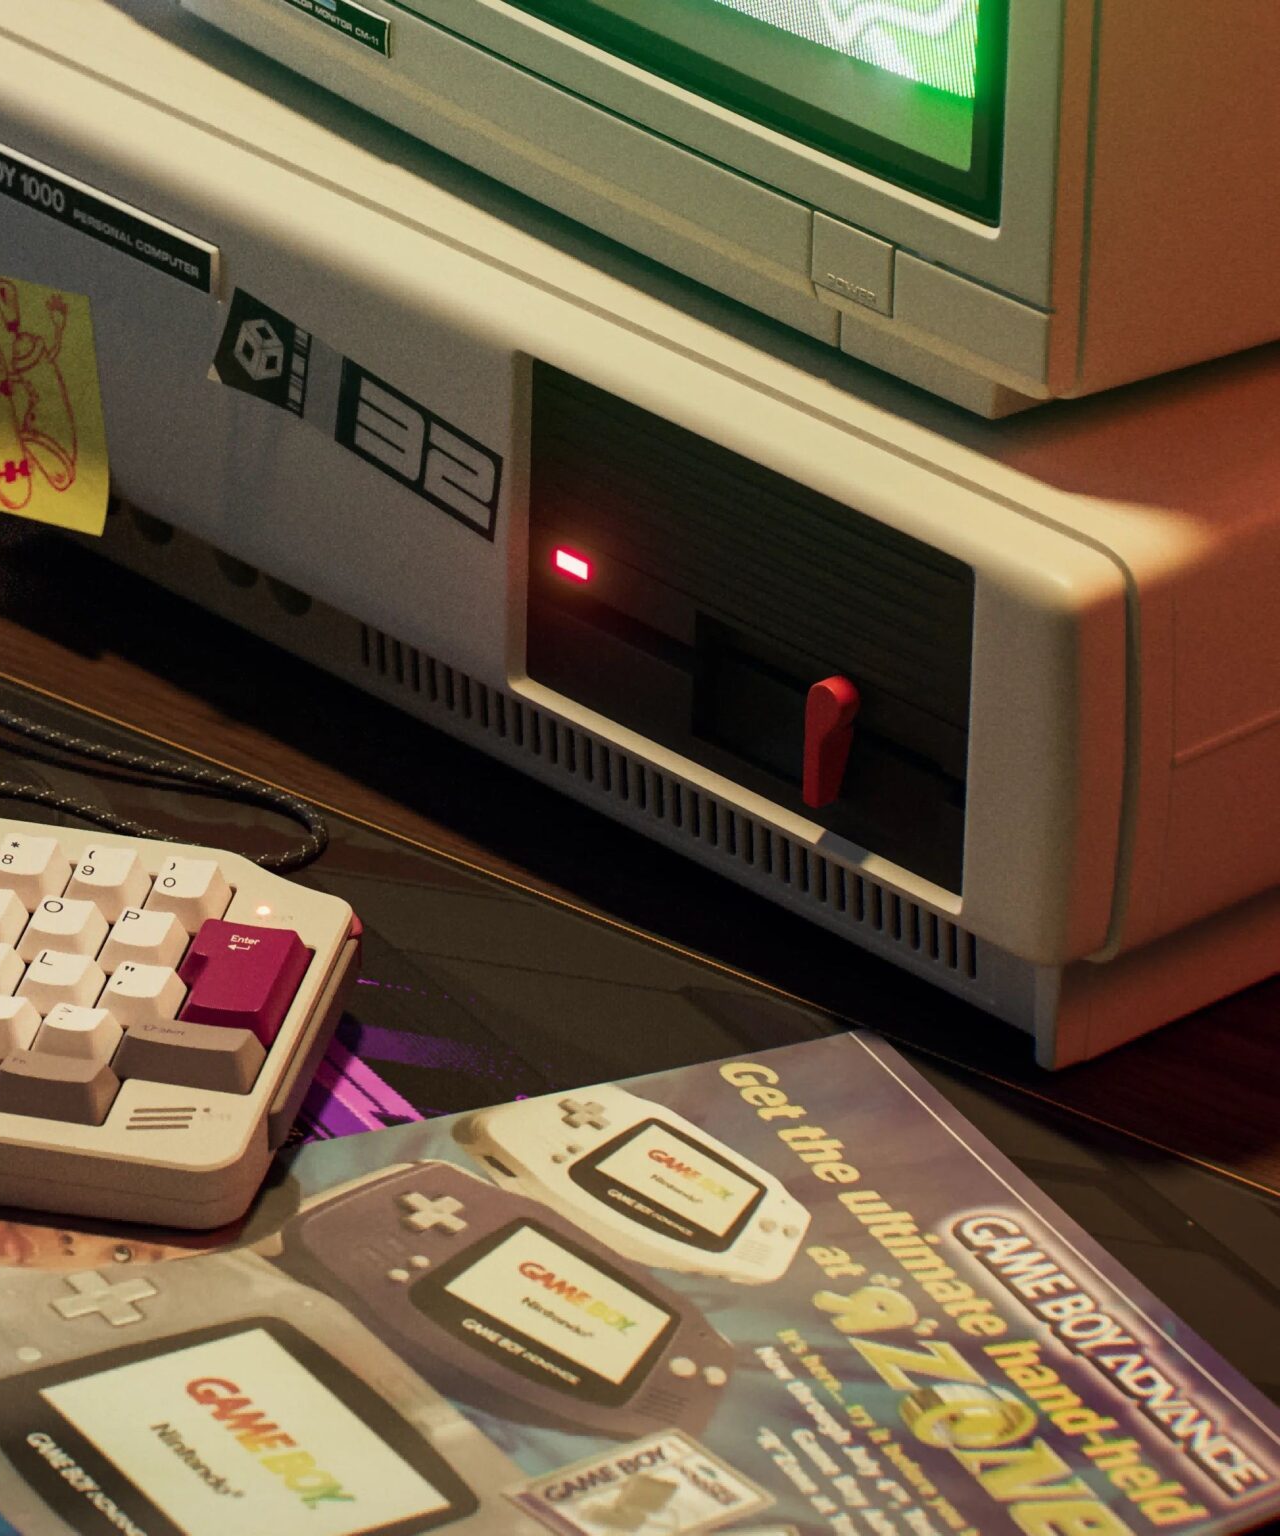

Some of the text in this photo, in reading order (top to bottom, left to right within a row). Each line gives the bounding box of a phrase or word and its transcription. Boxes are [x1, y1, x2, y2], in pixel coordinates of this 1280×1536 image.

[315, 6, 353, 31] MONITOR
[21, 173, 65, 213] 1000
[73, 208, 133, 247] PERSONAL
[136, 239, 199, 279] COMPUTER
[826, 272, 877, 304] POWER
[1, 854, 14, 865] 8
[81, 865, 95, 876] 9
[43, 900, 64, 913] O
[122, 910, 140, 922] P
[230, 934, 261, 946] Enter
[39, 952, 53, 966] L
[647, 1149, 702, 1179] GAME
[807, 1246, 866, 1278] at
[518, 1261, 637, 1335] GAME BOY
[719, 1062, 1210, 1527] Get the ultimate hand-held
[462, 1318, 501, 1342] GAME
[961, 1216, 1269, 1492] GAME BOY ADVANCE
[26, 1432, 75, 1470] GAME
[186, 1377, 356, 1510] GAME BOY
[543, 1446, 666, 1502] GAME BOY
